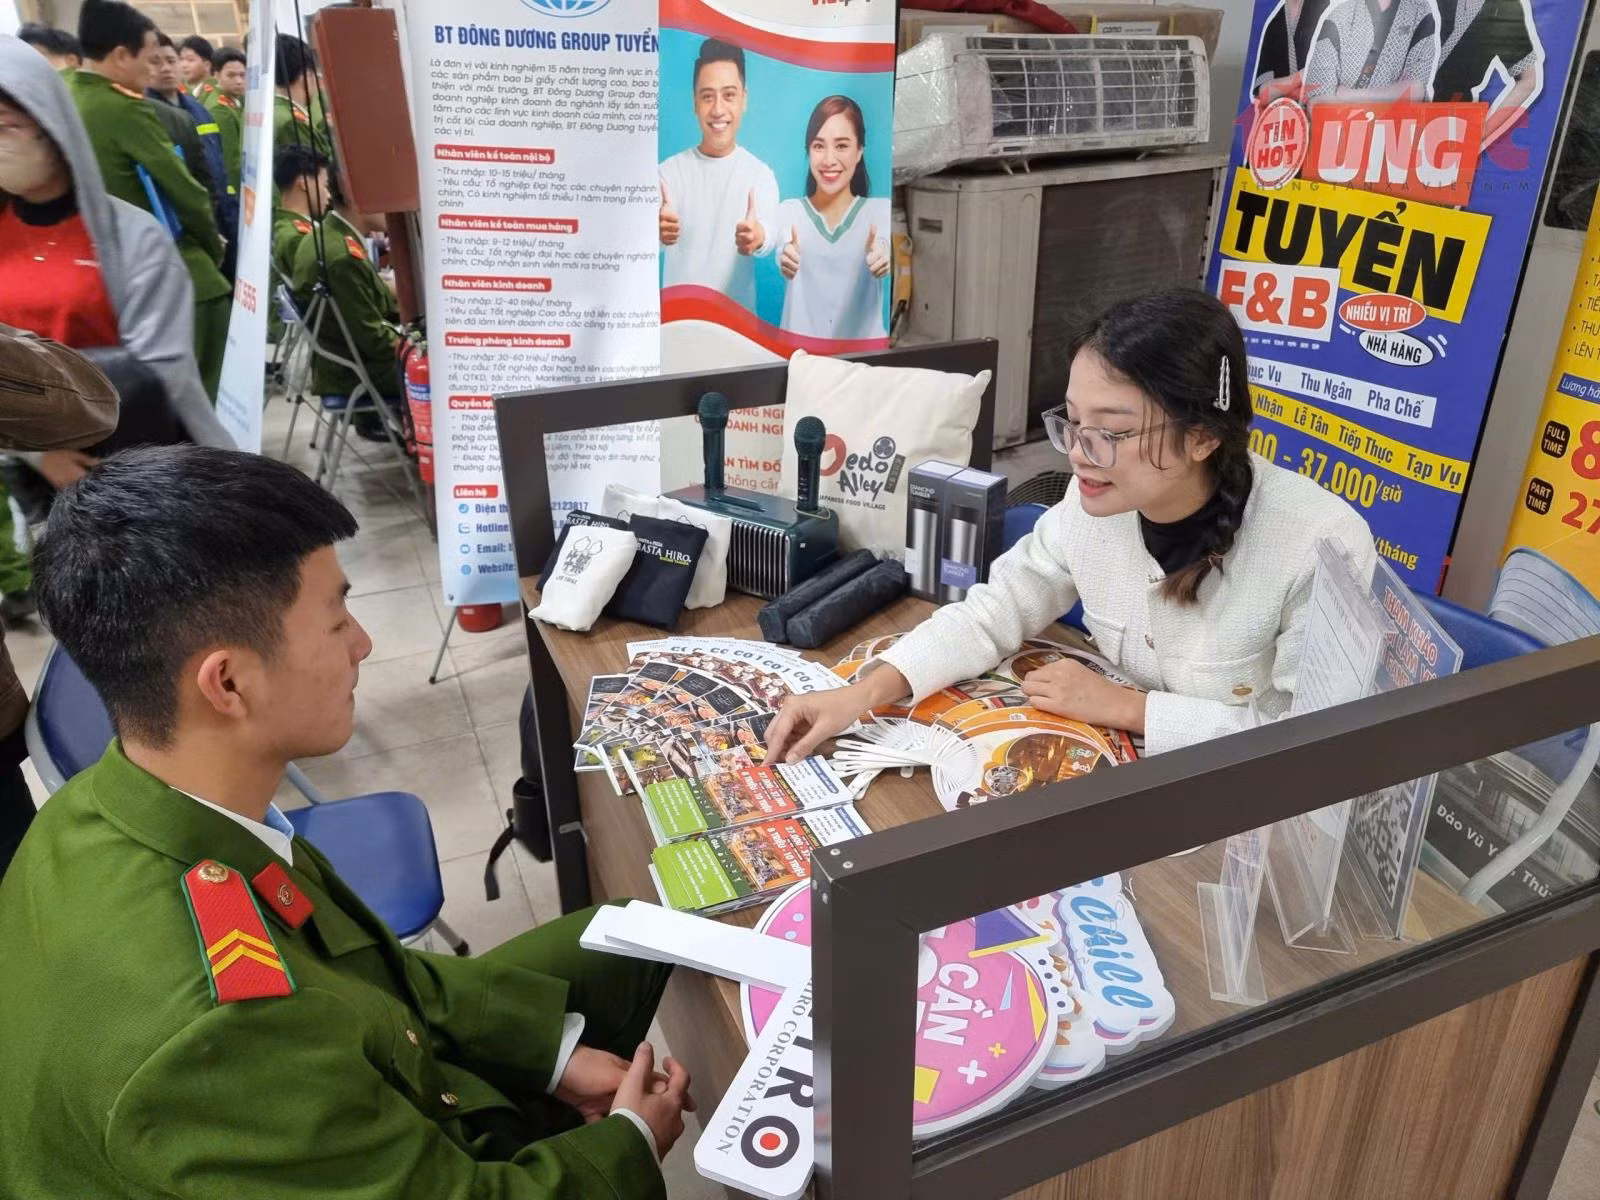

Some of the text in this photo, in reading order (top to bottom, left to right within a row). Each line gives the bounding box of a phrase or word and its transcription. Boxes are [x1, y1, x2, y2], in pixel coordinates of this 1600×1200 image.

[434, 22, 659, 52] BT ĐÔNG DƯƠNG GROUP TUYỂN
[490, 62, 508, 70] kinh
[583, 67, 606, 77] trong
[503, 74, 521, 83] bao
[437, 148, 464, 159] Nhân
[465, 150, 485, 160] viên
[1257, 144, 1298, 170] HOT
[1317, 108, 1469, 188] ỨNG
[1235, 200, 1466, 311] TUYỂN
[1220, 269, 1332, 331] F&B
[1380, 306, 1391, 326] VỊ
[1393, 302, 1411, 324] TRÍ
[1366, 331, 1423, 364] NHÀ HÀNG
[1574, 341, 1594, 359] LÊN
[1268, 365, 1282, 386] Vụ
[1301, 372, 1320, 393] Thu
[1323, 378, 1352, 401] Ngân
[1367, 390, 1390, 412] Pha
[1394, 395, 1425, 419] Chế
[1561, 377, 1586, 397] Lương
[1255, 394, 1462, 490] Nhận Lễ Tân Tiếp Thực Tạp Vụ
[1546, 424, 1566, 442] FULL
[1543, 437, 1564, 456] TIME
[738, 455, 759, 470] TÌM
[836, 469, 884, 502] Alley
[1530, 482, 1551, 499] PART
[475, 503, 496, 515] Điện
[1528, 494, 1548, 512] TIME
[1436, 804, 1463, 831] Đảo
[1467, 827, 1485, 848] Vũ
[715, 1019, 798, 1156] CORPORATION
